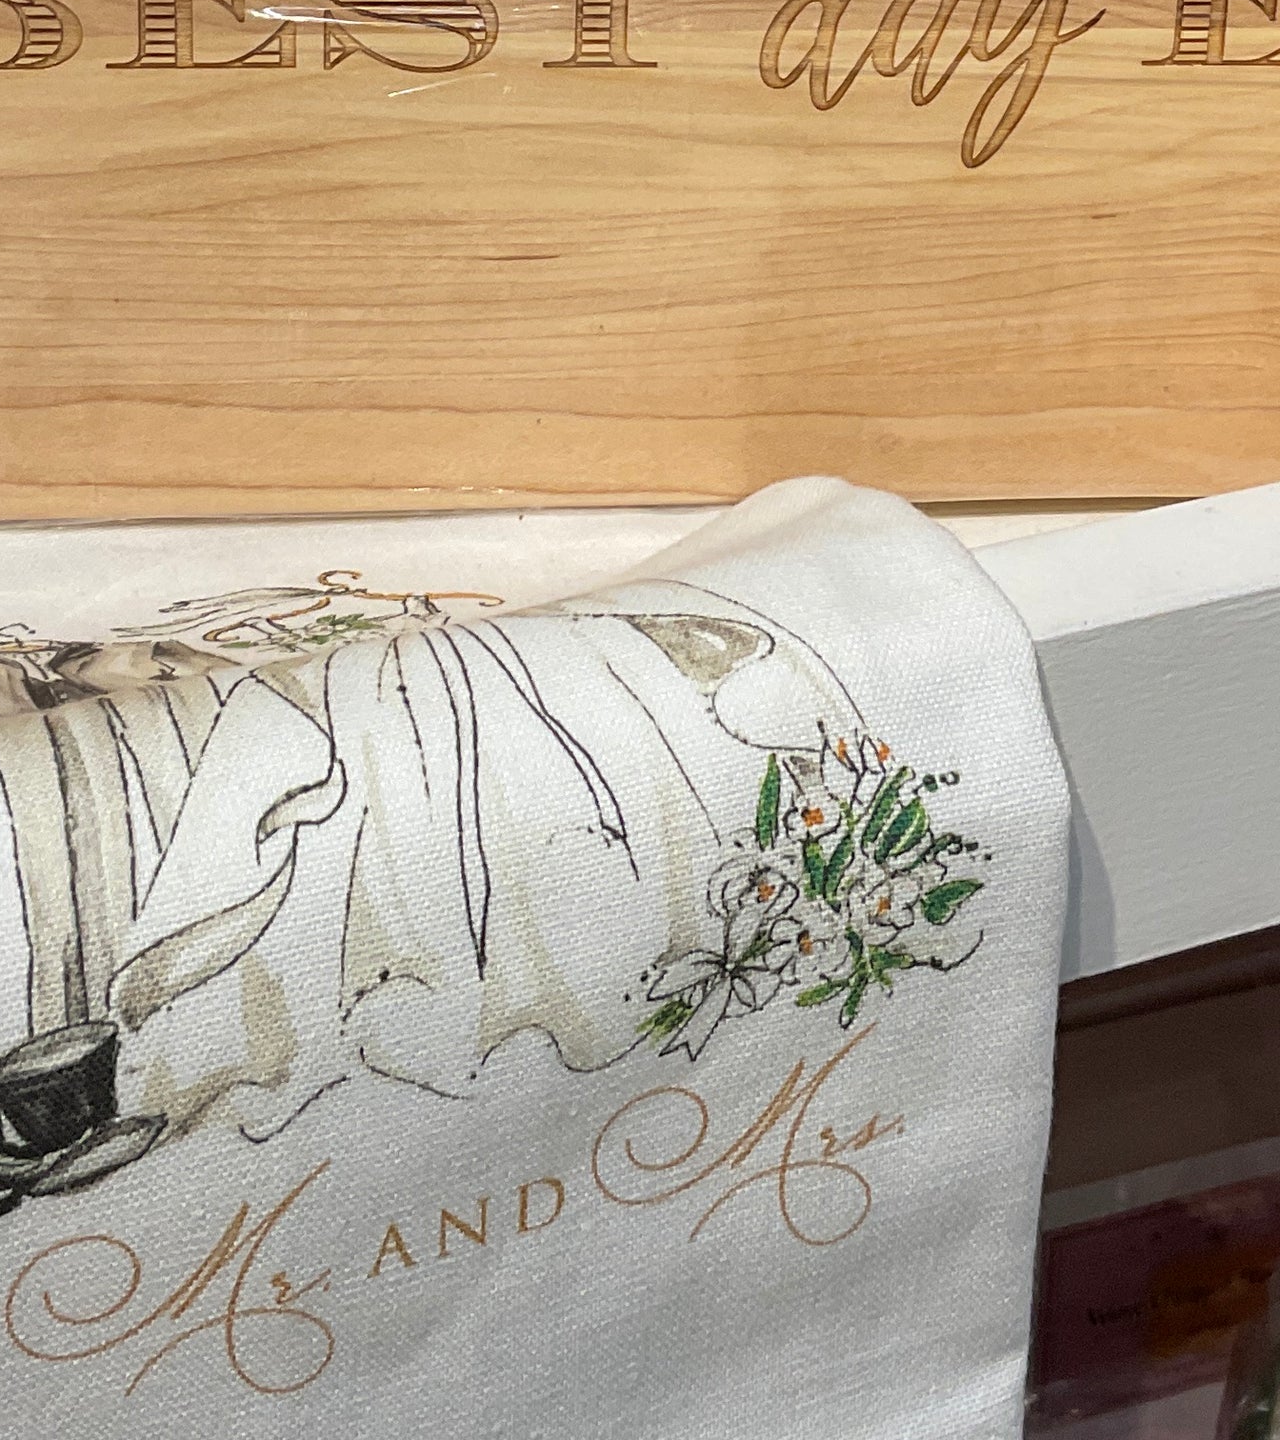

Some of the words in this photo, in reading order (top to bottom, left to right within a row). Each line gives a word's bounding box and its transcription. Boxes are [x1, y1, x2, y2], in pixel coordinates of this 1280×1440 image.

[5, 1160, 334, 1396] Mr.
[365, 1175, 567, 1281] AND
[591, 1023, 908, 1247] Mrs.
